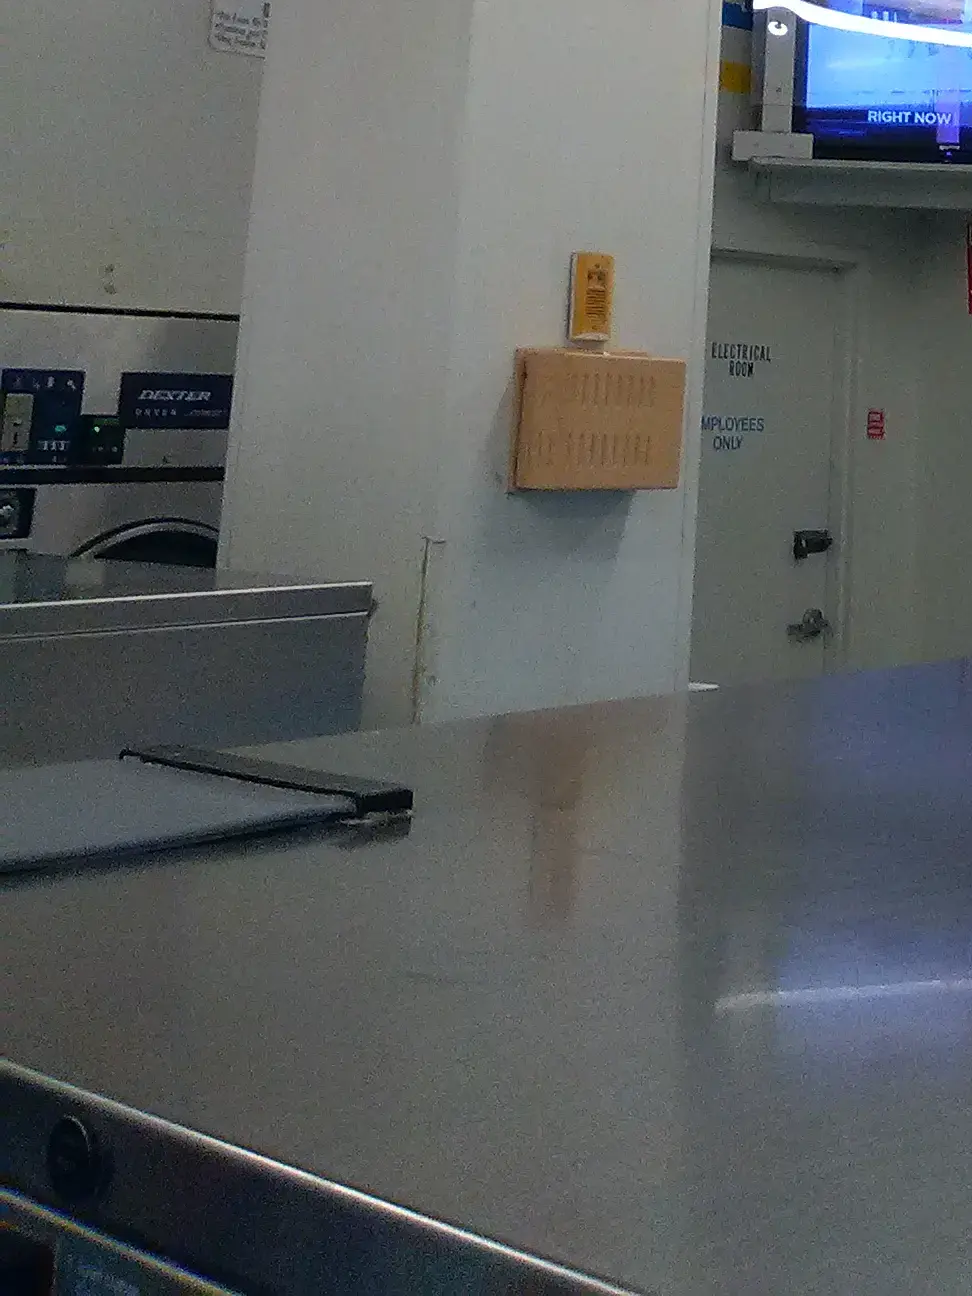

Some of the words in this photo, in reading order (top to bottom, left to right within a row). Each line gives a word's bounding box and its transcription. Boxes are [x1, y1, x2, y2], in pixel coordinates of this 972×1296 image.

[868, 110, 912, 123] RIGHT
[914, 111, 952, 124] NOW
[711, 342, 771, 362] ELECTRICAL
[729, 360, 754, 377] ROOM
[138, 389, 211, 401] DEXTER
[701, 415, 765, 432] MPLOYEES
[713, 435, 743, 451] ONLY
